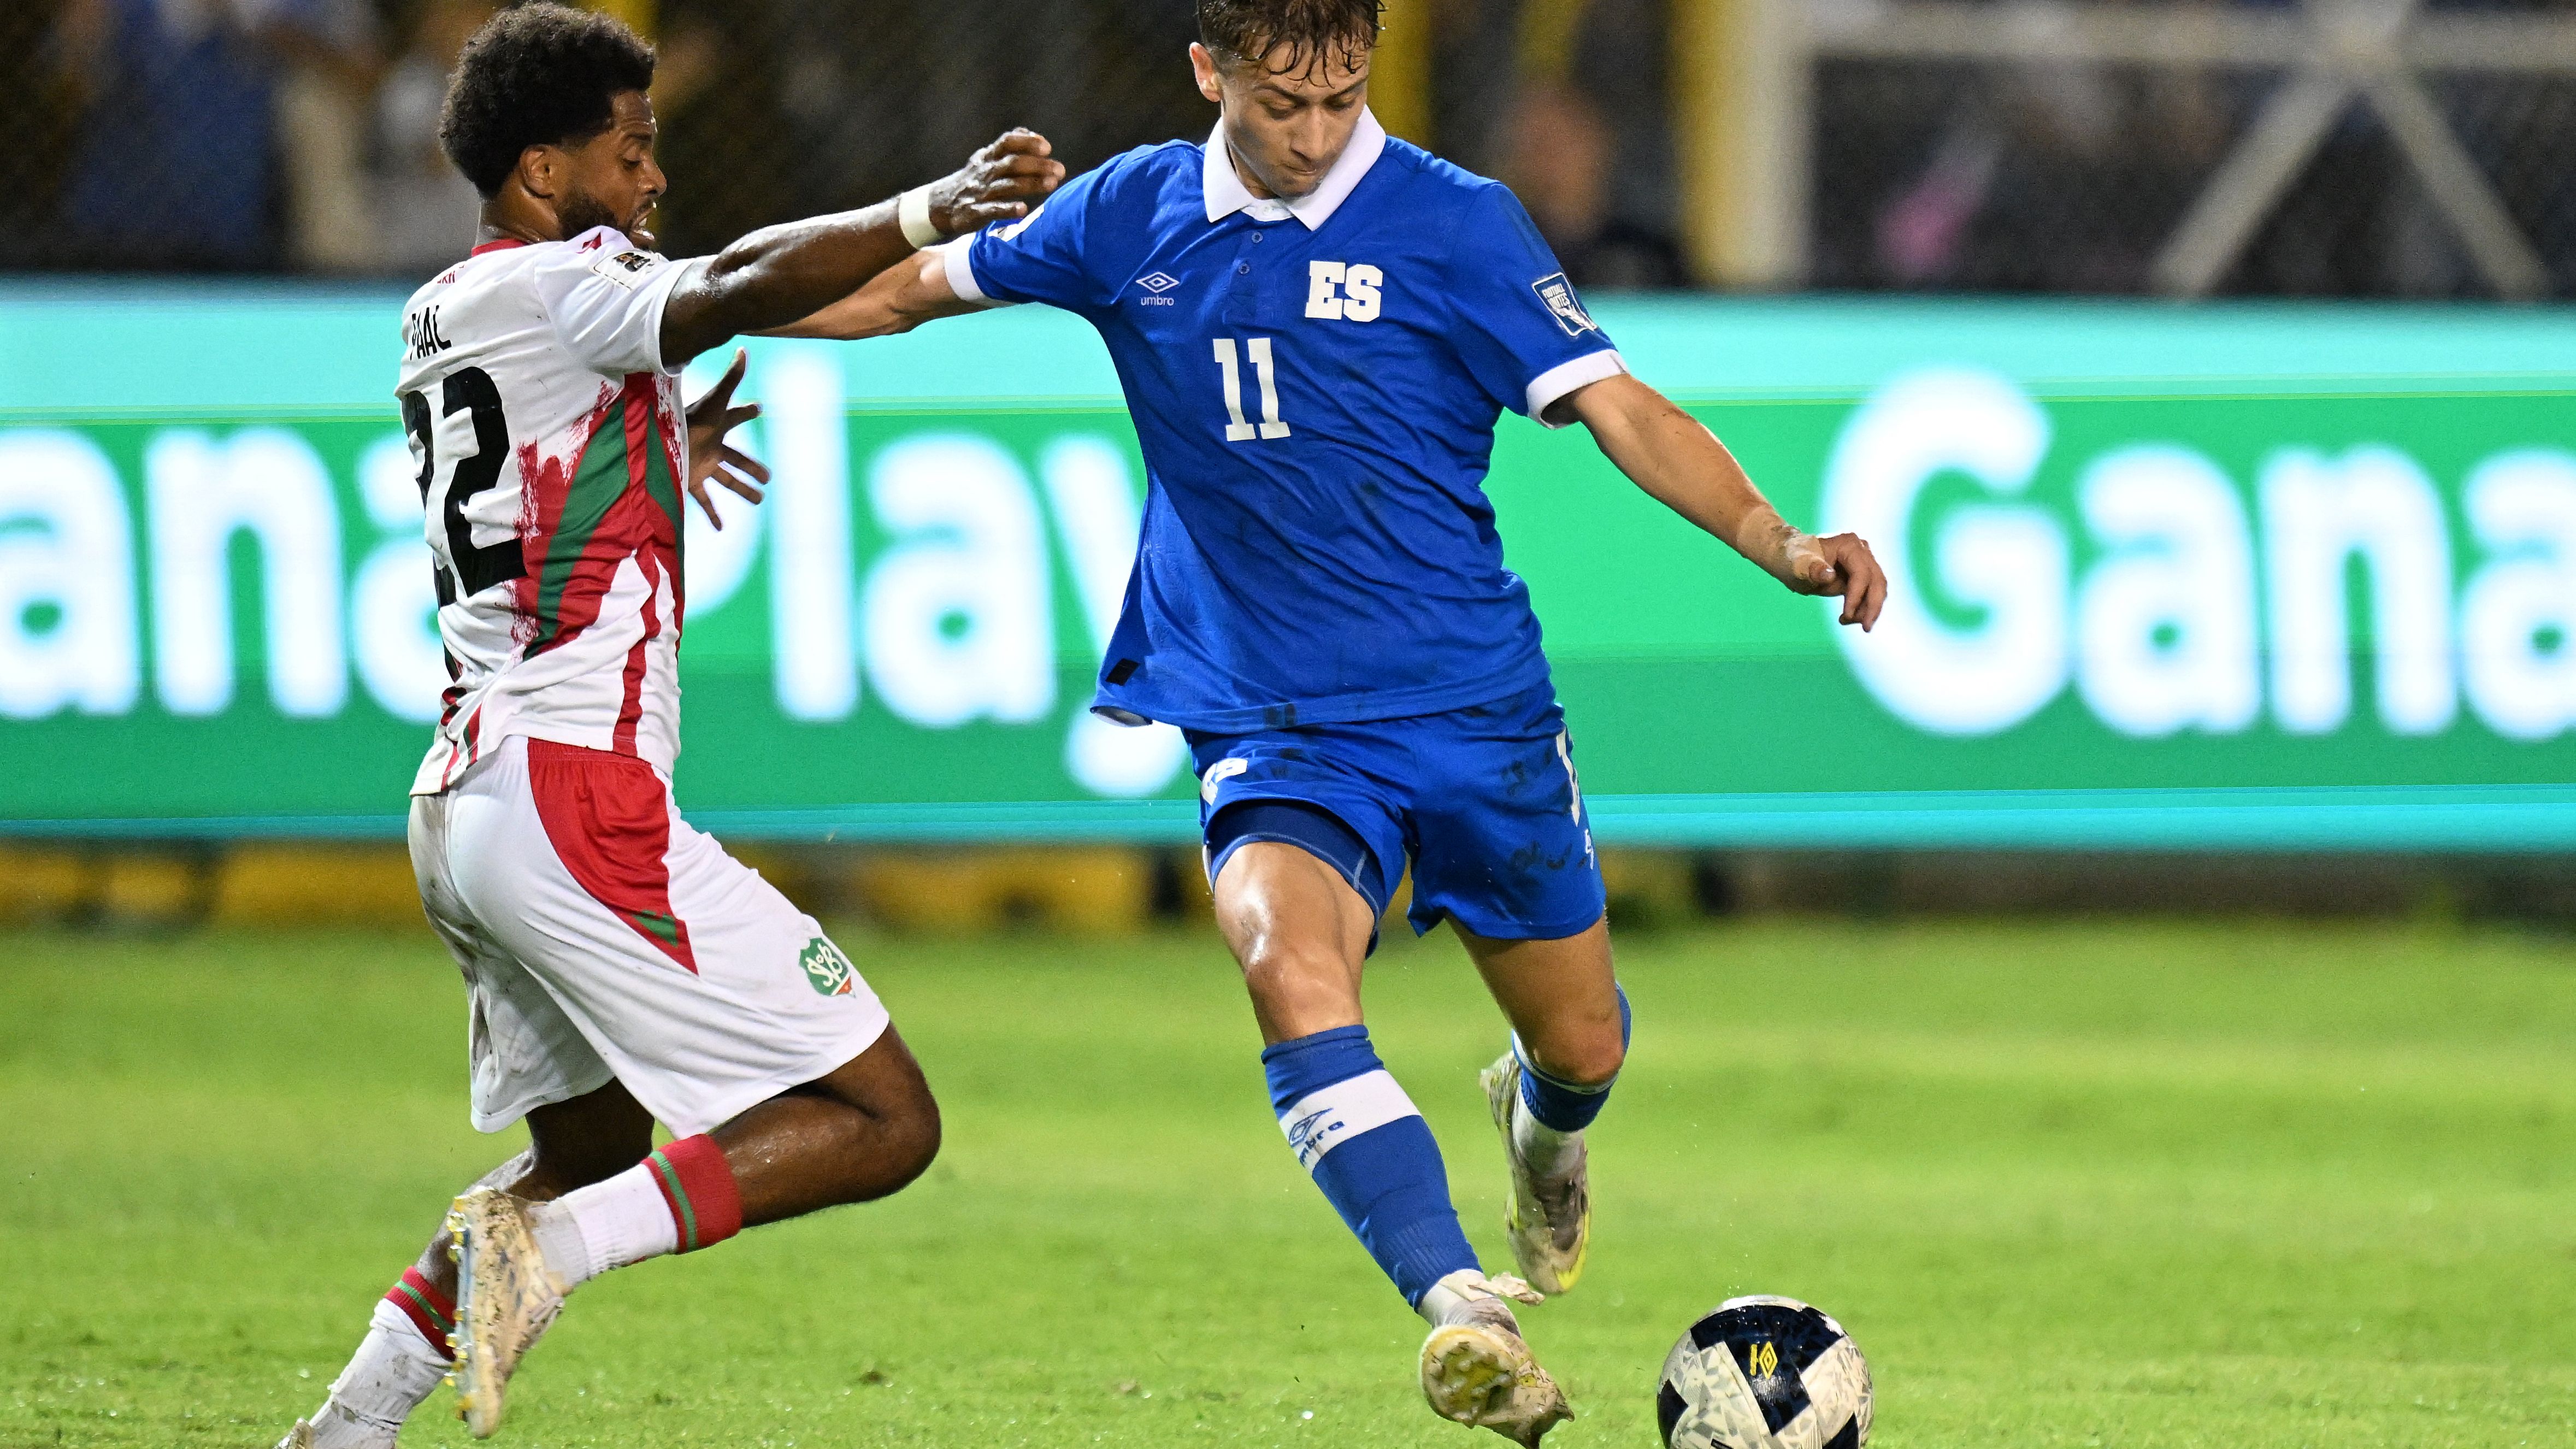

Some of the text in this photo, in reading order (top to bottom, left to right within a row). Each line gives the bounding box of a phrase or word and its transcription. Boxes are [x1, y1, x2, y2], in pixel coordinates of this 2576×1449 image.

[1140, 295, 1175, 307] umbro
[1305, 261, 1383, 322] ES
[1212, 337, 1291, 441] 11
